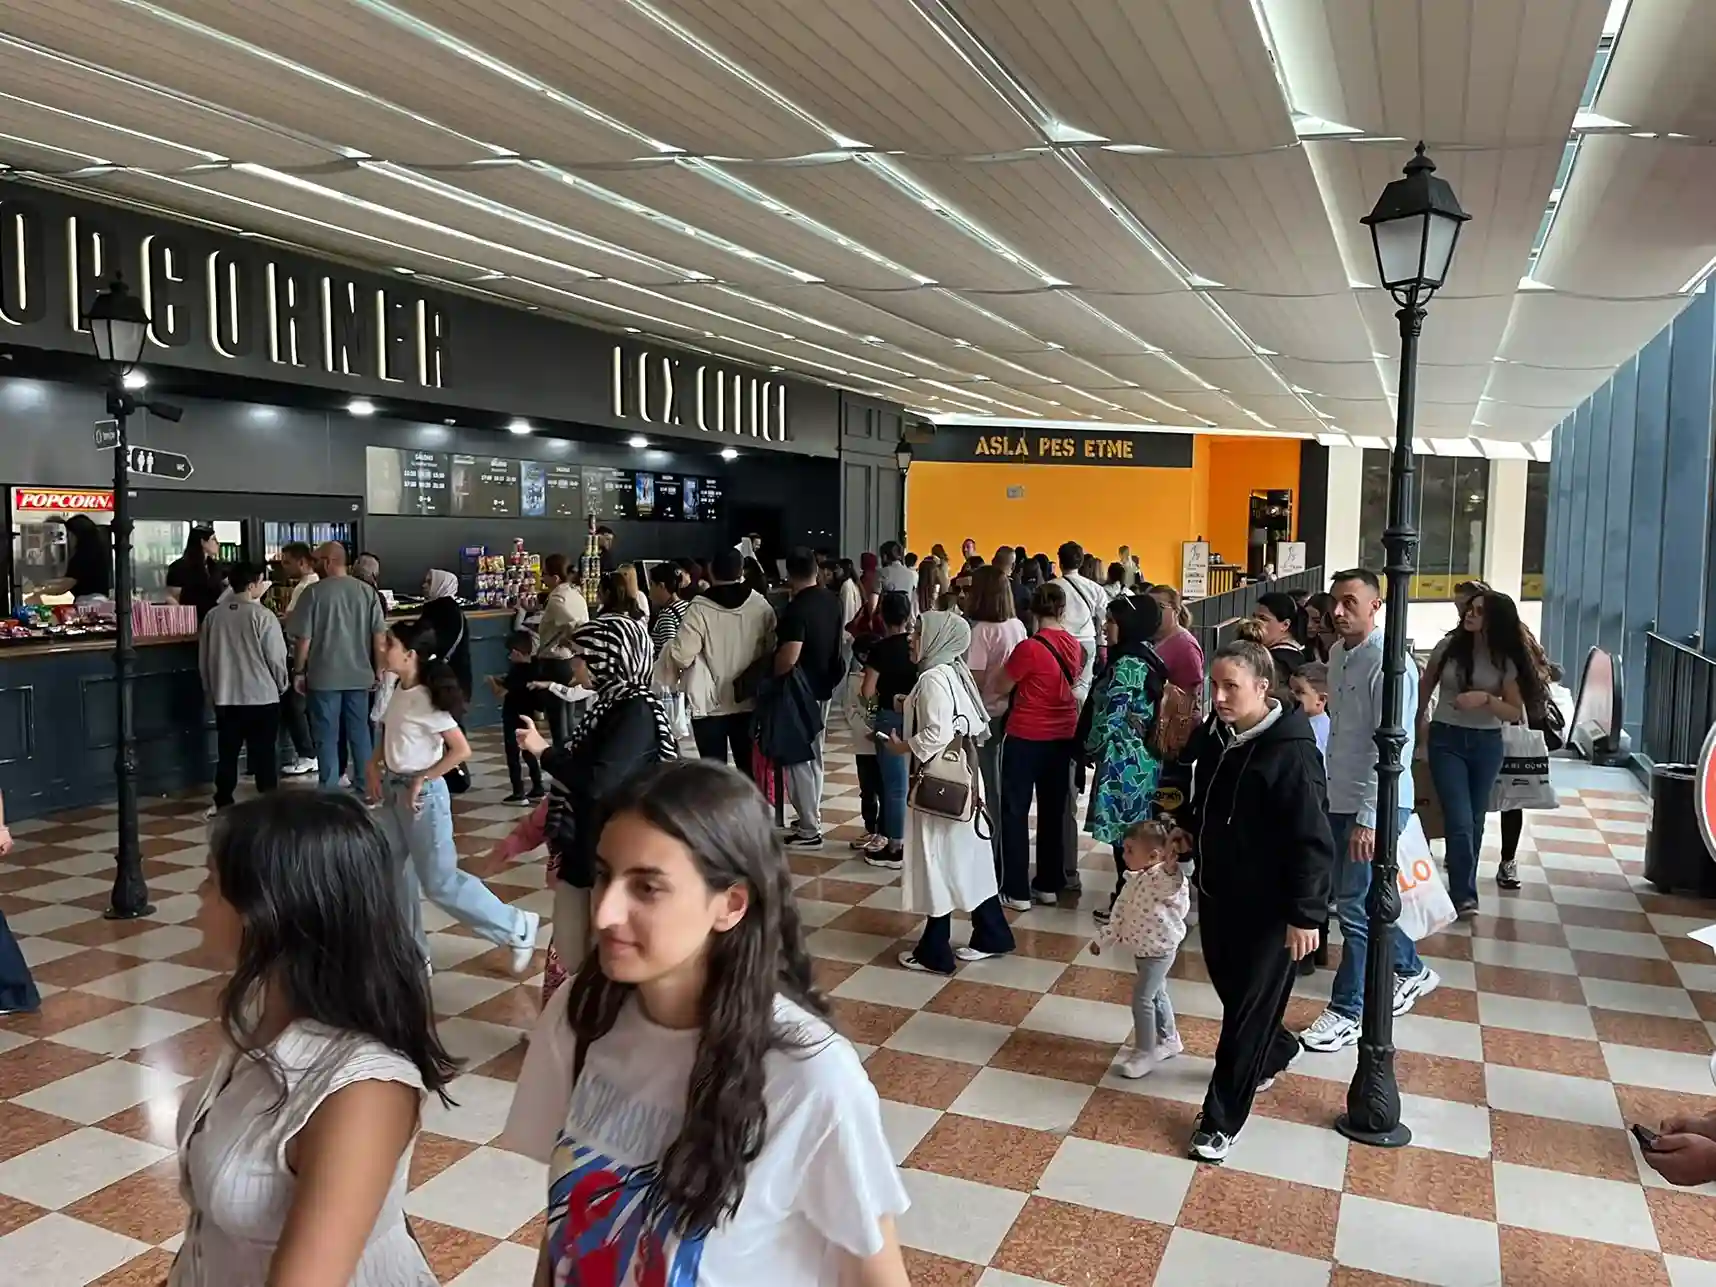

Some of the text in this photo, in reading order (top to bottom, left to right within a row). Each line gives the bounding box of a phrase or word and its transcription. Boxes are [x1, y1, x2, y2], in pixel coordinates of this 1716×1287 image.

[975, 436, 1133, 459] ASLA PES ETME
[21, 493, 109, 508] POPCORN
